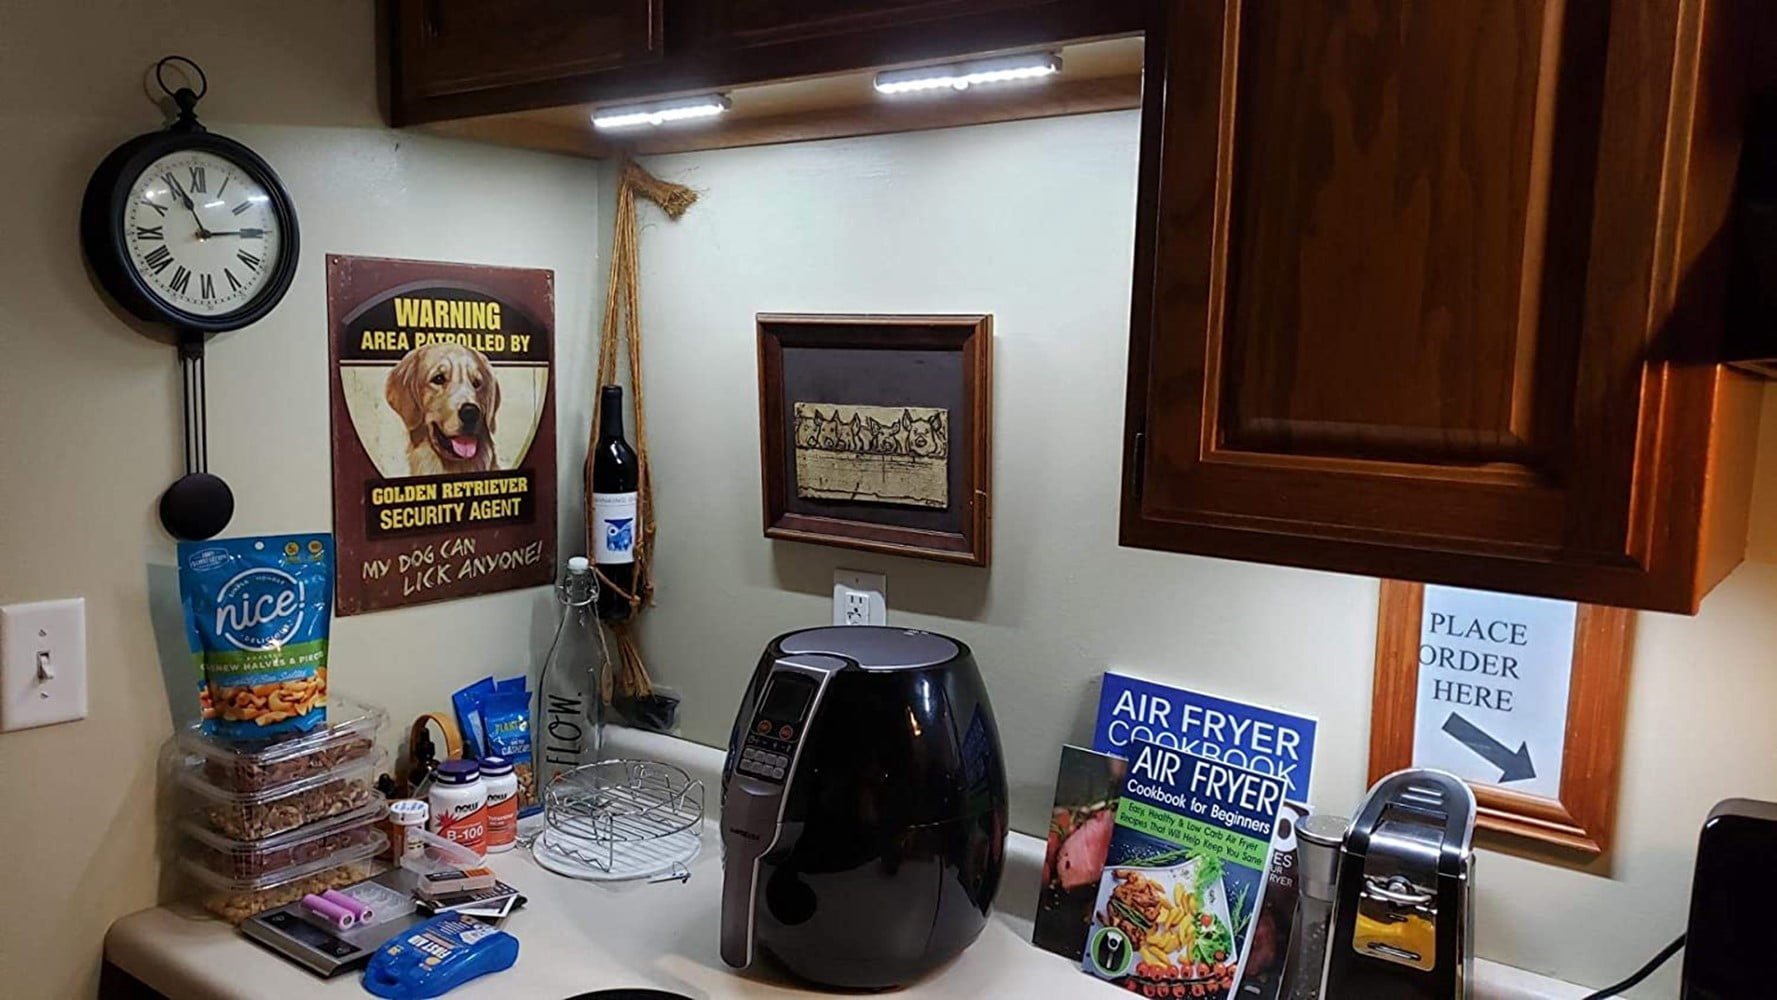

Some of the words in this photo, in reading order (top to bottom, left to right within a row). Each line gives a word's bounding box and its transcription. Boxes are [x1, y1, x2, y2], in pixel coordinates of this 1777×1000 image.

[394, 298, 501, 331] WARNING
[360, 331, 410, 350] AREA
[510, 335, 531, 353] BY
[371, 483, 438, 505] GOLDEN
[442, 477, 528, 499] RETRIEVER
[380, 502, 465, 530] SECURITY
[469, 498, 522, 521] AGENT
[362, 558, 391, 580] MY
[398, 545, 435, 573] DOG
[440, 538, 477, 560] CAN
[403, 564, 452, 597] LICK
[458, 540, 543, 580] ANYONE!
[1429, 612, 1528, 646] PLACE
[1418, 644, 1521, 680] ORDER
[1433, 679, 1514, 712] HERE
[1112, 690, 1172, 728] AIR
[1181, 703, 1301, 761] FRYER
[1108, 720, 1298, 791] COOKBOOK
[1131, 746, 1182, 786] AIR
[1190, 761, 1280, 816] FRYER
[1127, 779, 1187, 809] Cookbook
[1191, 795, 1208, 815] for
[1210, 805, 1271, 835] Beginners
[446, 825, 483, 841] B-100
[1119, 812, 1148, 829] Recipes
[1149, 821, 1166, 834] That
[1167, 828, 1181, 839] Will
[1182, 833, 1201, 847] Help
[1203, 839, 1224, 854] Keep
[1226, 846, 1240, 859] You
[1242, 852, 1263, 866] Sane
[1148, 808, 1176, 827] Healthy
[1178, 818, 1184, 828] &
[1187, 822, 1202, 833] Low
[1204, 826, 1224, 840] Carb
[1225, 834, 1237, 844] Air
[1238, 837, 1259, 852] Fryer
